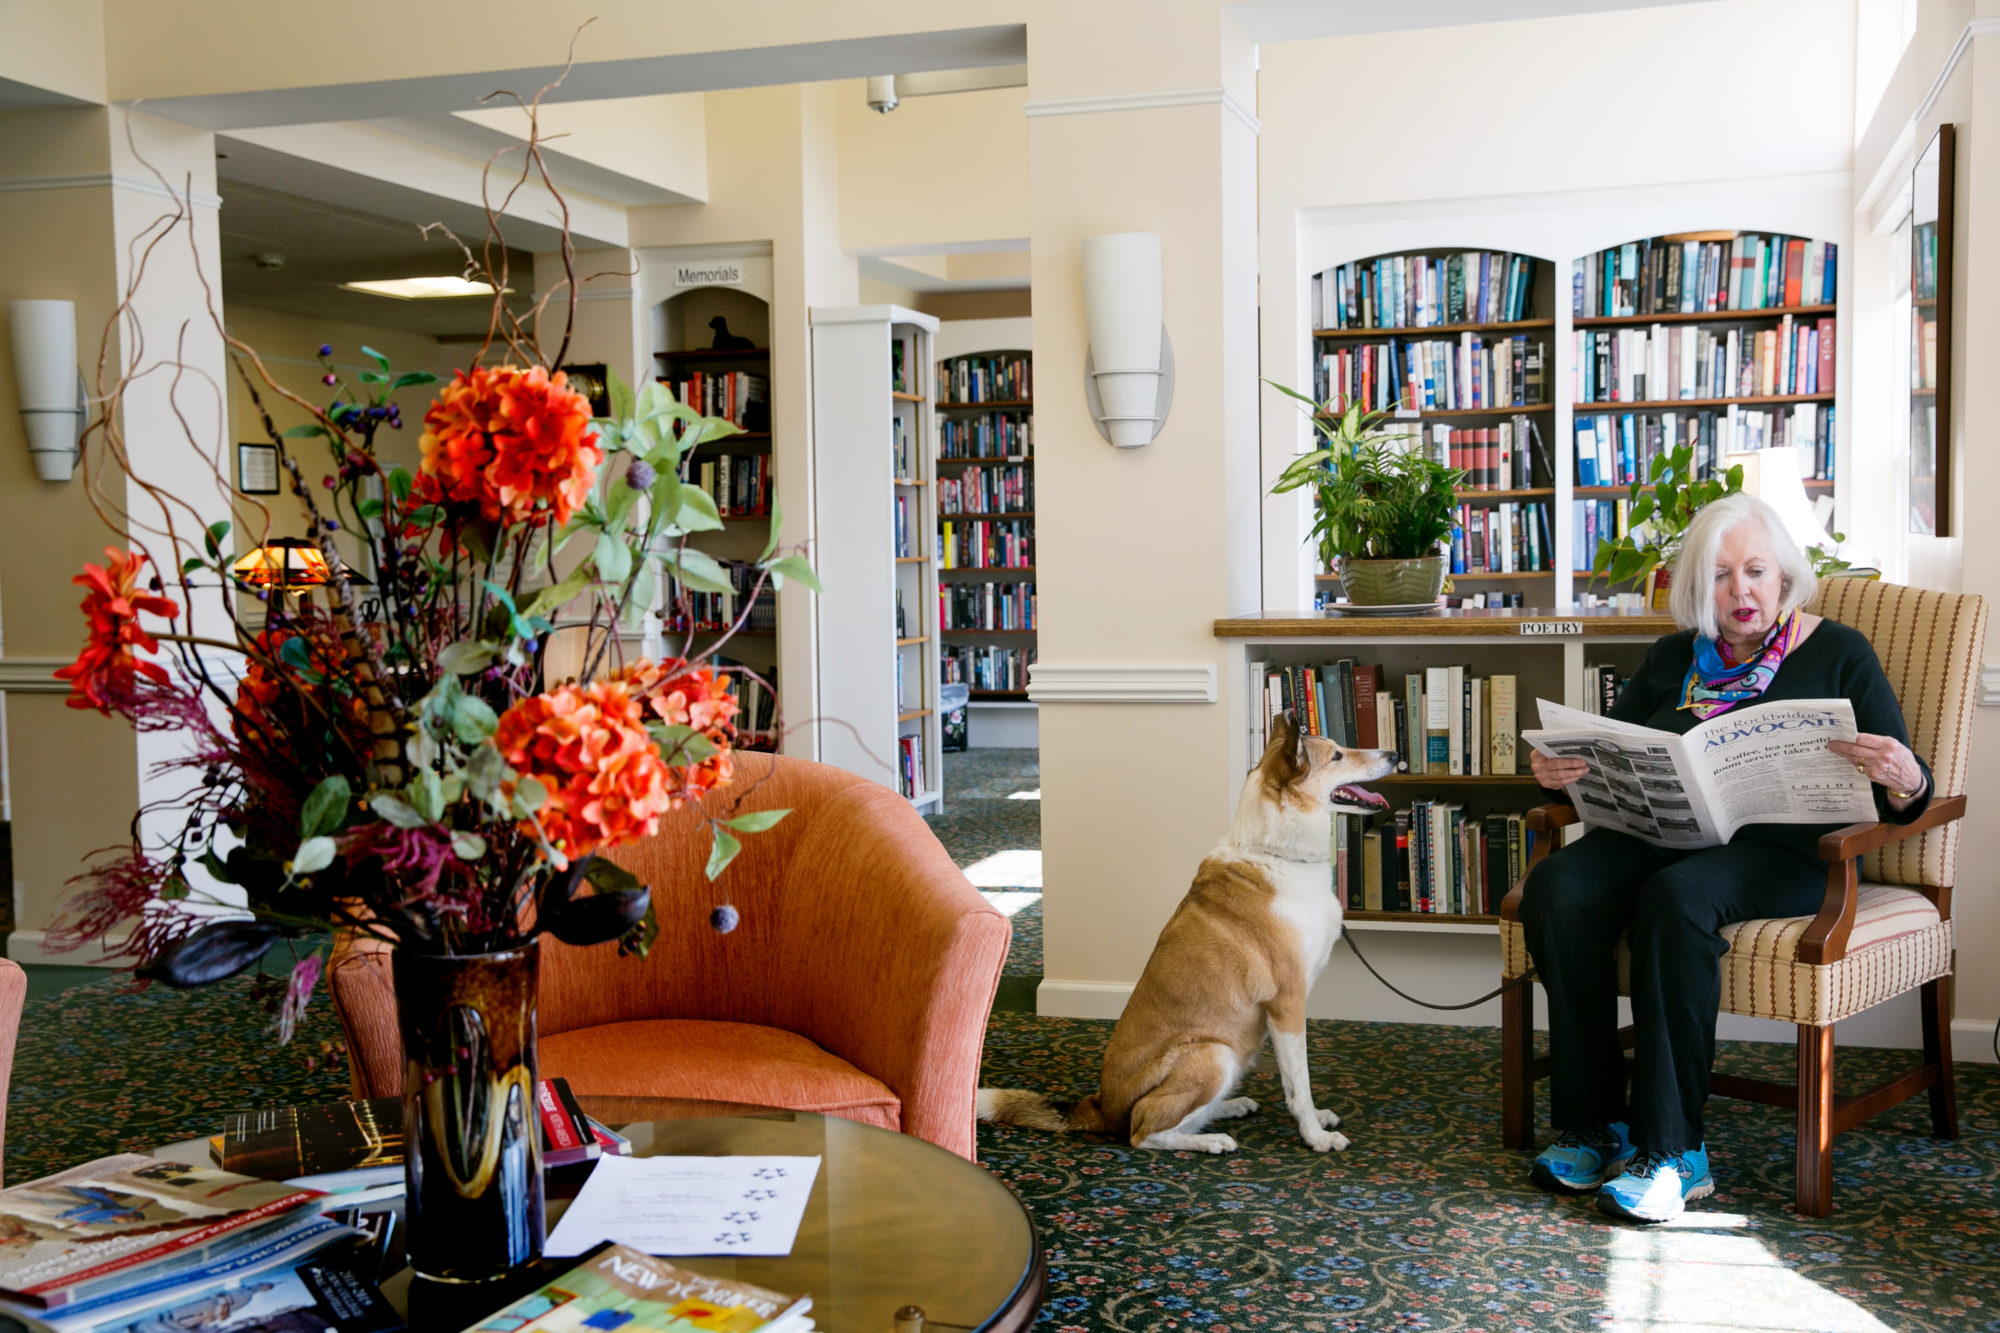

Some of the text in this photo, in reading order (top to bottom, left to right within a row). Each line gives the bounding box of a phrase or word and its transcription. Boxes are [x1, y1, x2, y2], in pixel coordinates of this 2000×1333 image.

[678, 267, 739, 284] Memorials
[1522, 622, 1581, 634] POETRY
[1605, 674, 1615, 711] PARN
[1703, 711, 1820, 739] The Rockbridge
[1703, 718, 1842, 752] ADVOCATE
[1713, 760, 1742, 776] Room
[1744, 751, 1780, 764] service
[1783, 746, 1811, 756] takes
[1725, 749, 1762, 762] Coffee,
[598, 1255, 674, 1291] NEW
[667, 1283, 778, 1319] YORKER
